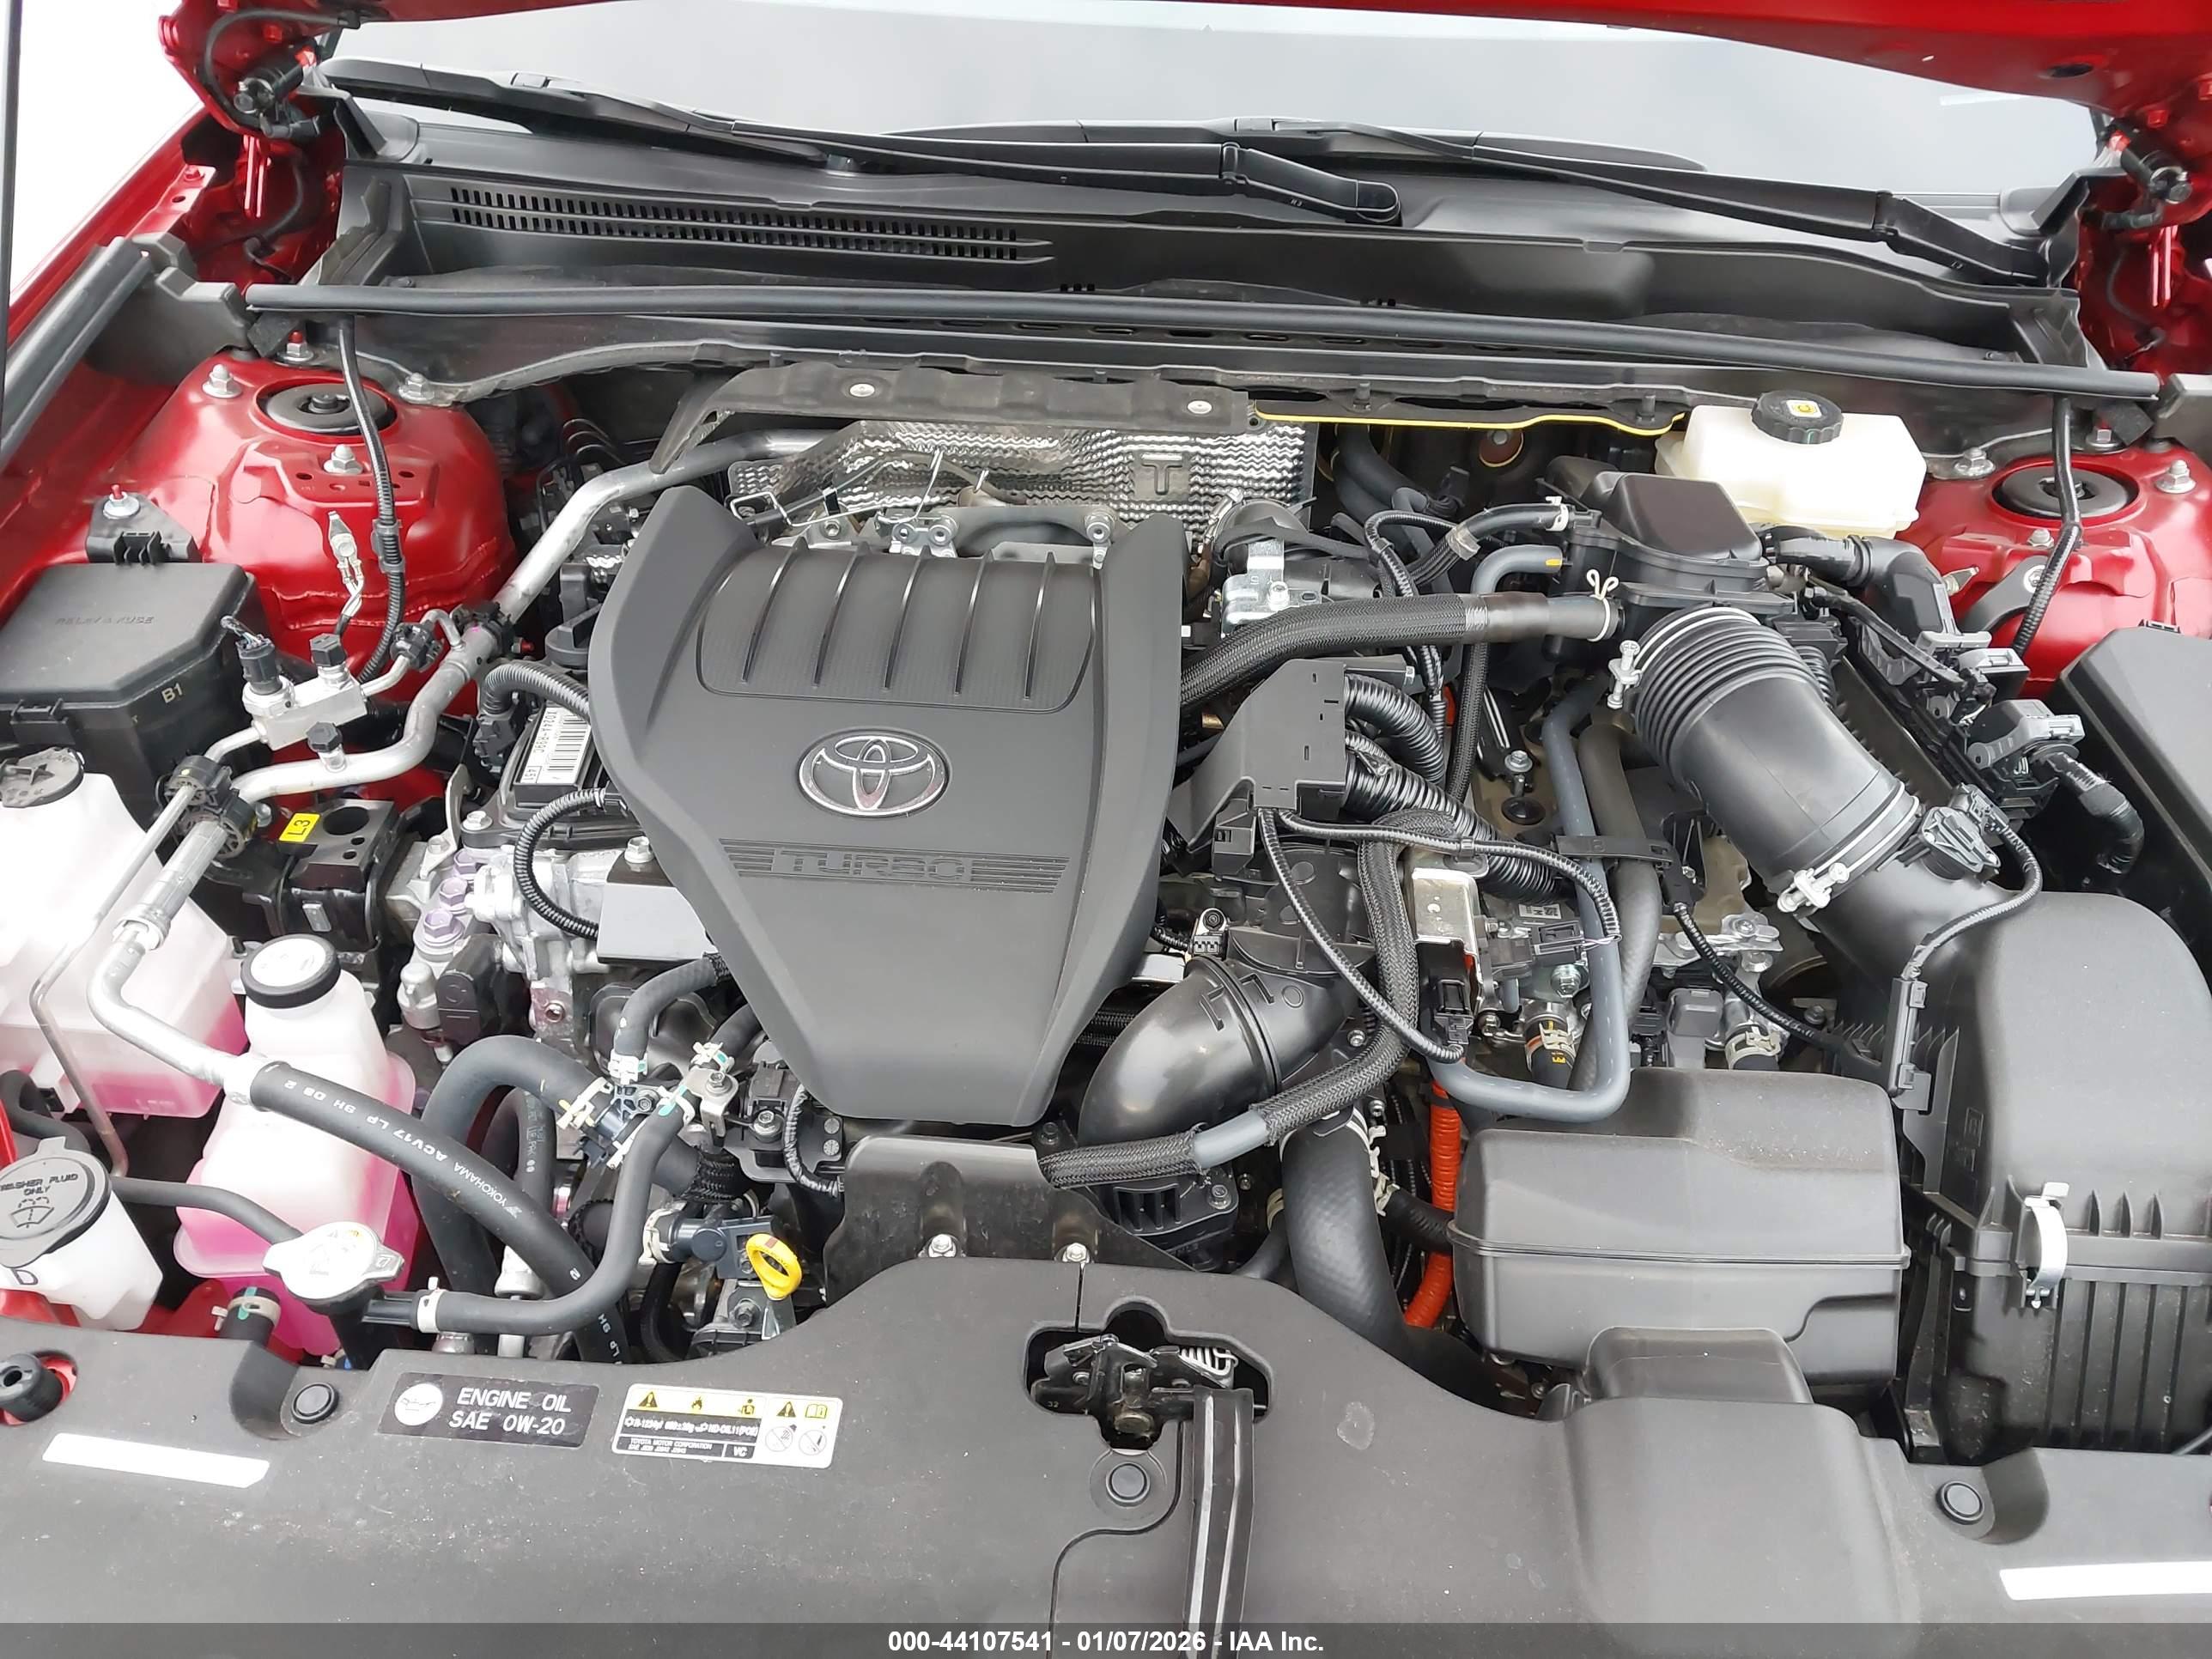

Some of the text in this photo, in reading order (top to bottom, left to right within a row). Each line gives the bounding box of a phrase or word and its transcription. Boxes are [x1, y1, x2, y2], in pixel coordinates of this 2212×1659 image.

[161, 683, 184, 704] B1
[286, 819, 311, 836] L3
[780, 849, 966, 881] TURBO
[283, 1079, 296, 1091] 2
[333, 1099, 357, 1114] 9H
[366, 1115, 390, 1130] LP
[392, 1128, 448, 1162] ACV17
[49, 1173, 79, 1184] FLUID
[453, 1161, 509, 1207] YOKOHAMA
[24, 1184, 51, 1196] ONLY
[457, 1387, 573, 1413] ENGINE OIL
[448, 1410, 566, 1436] SAE 0W-20
